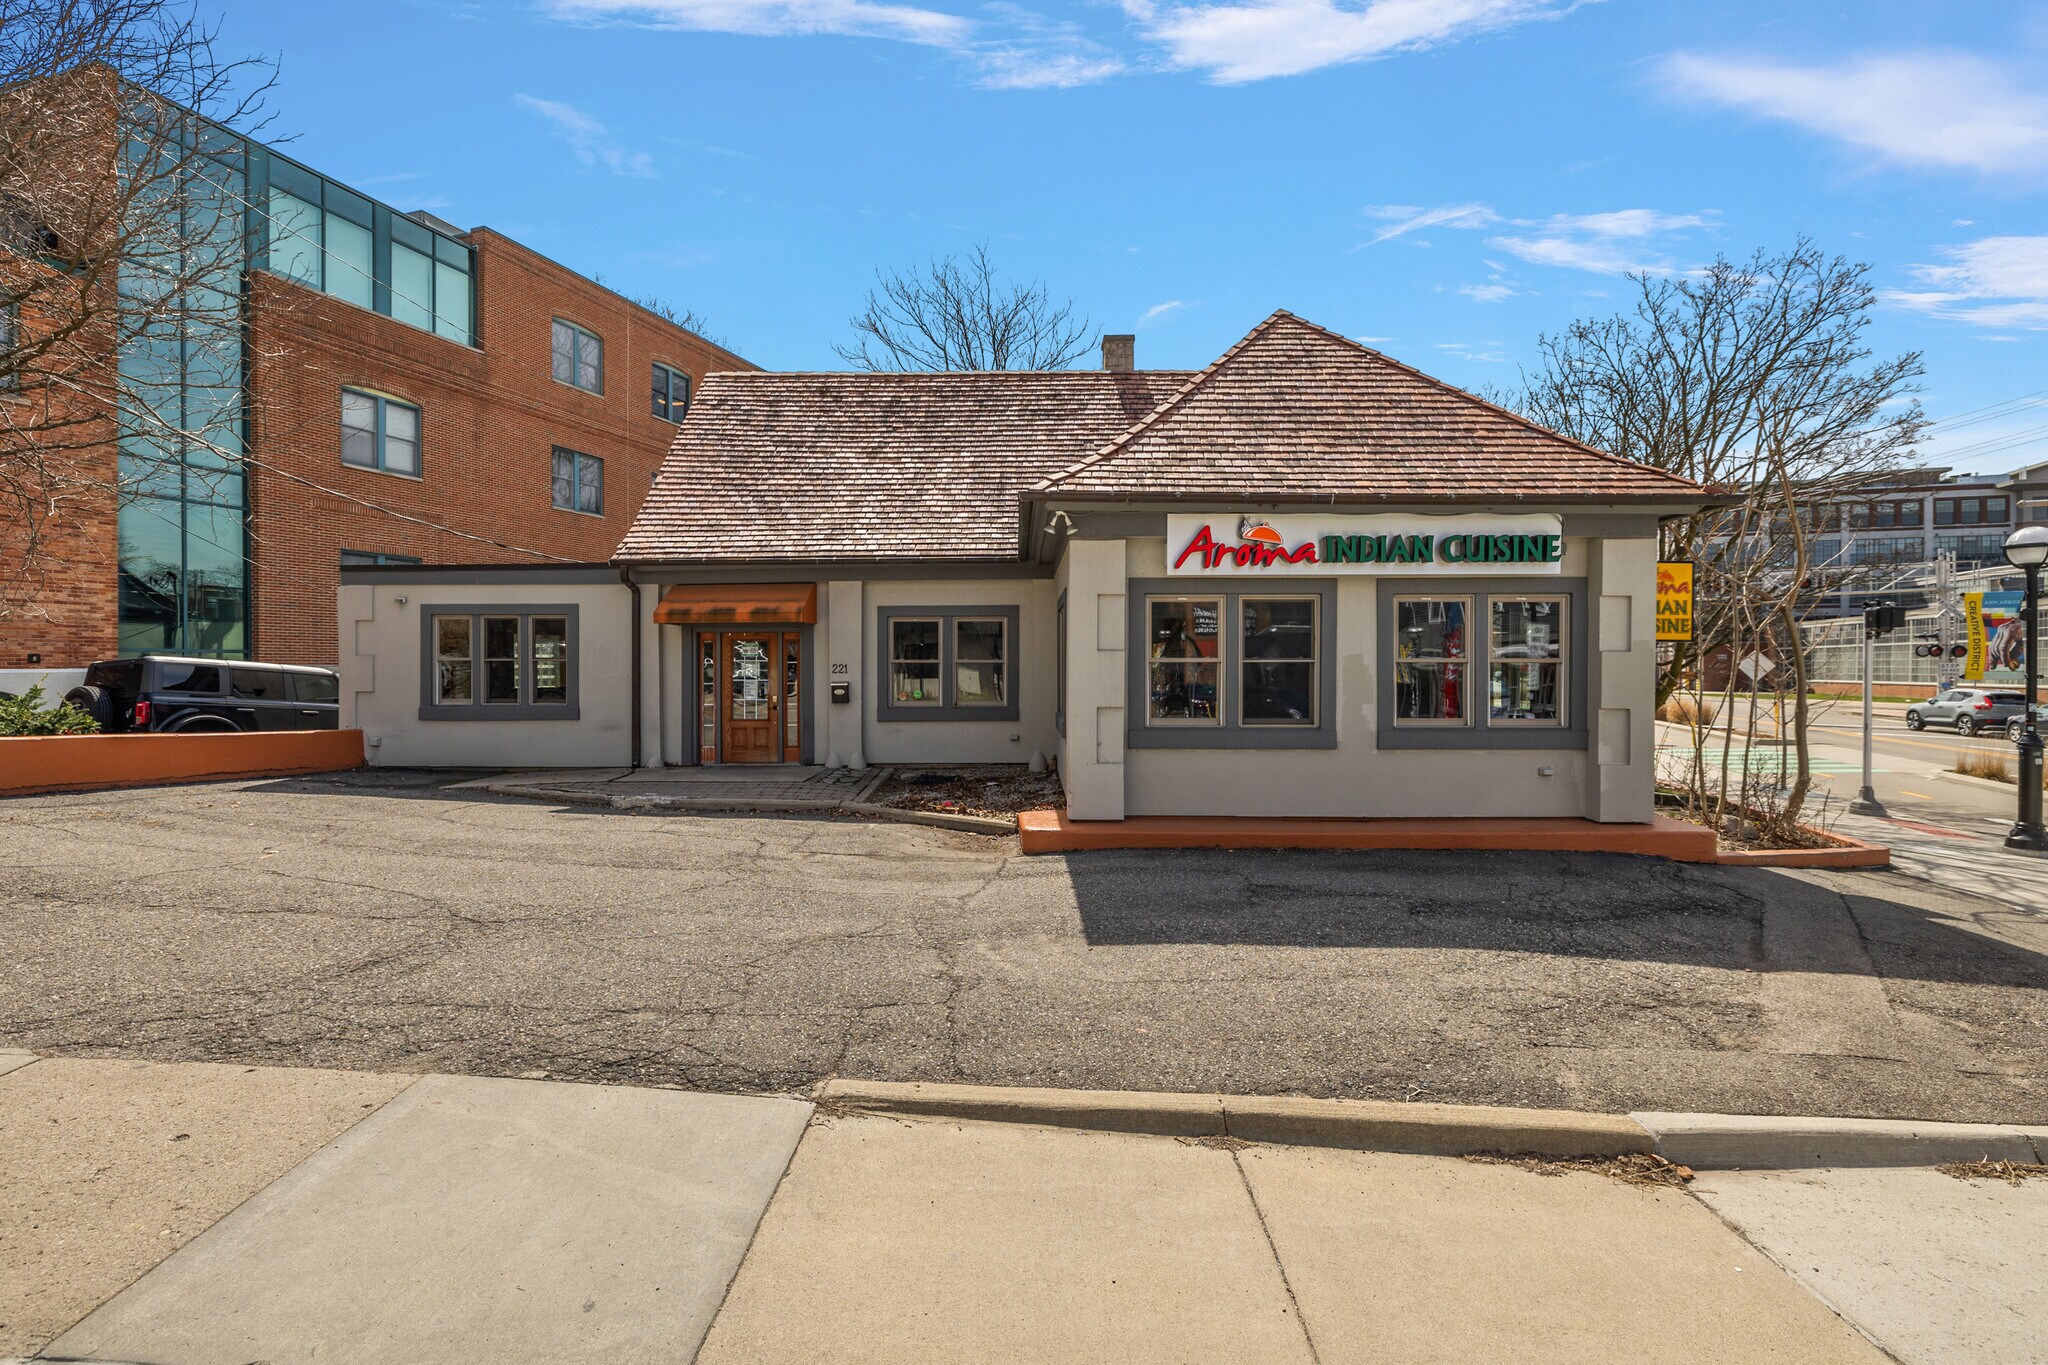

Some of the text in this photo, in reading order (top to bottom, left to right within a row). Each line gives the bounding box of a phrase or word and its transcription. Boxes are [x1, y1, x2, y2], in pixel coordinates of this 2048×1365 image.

[1174, 525, 1561, 569] Aroma INDIAN CUISINE
[1656, 581, 1691, 596] ma
[1968, 600, 1981, 672] CREATIVE DISTRICT
[832, 663, 848, 674] 221
